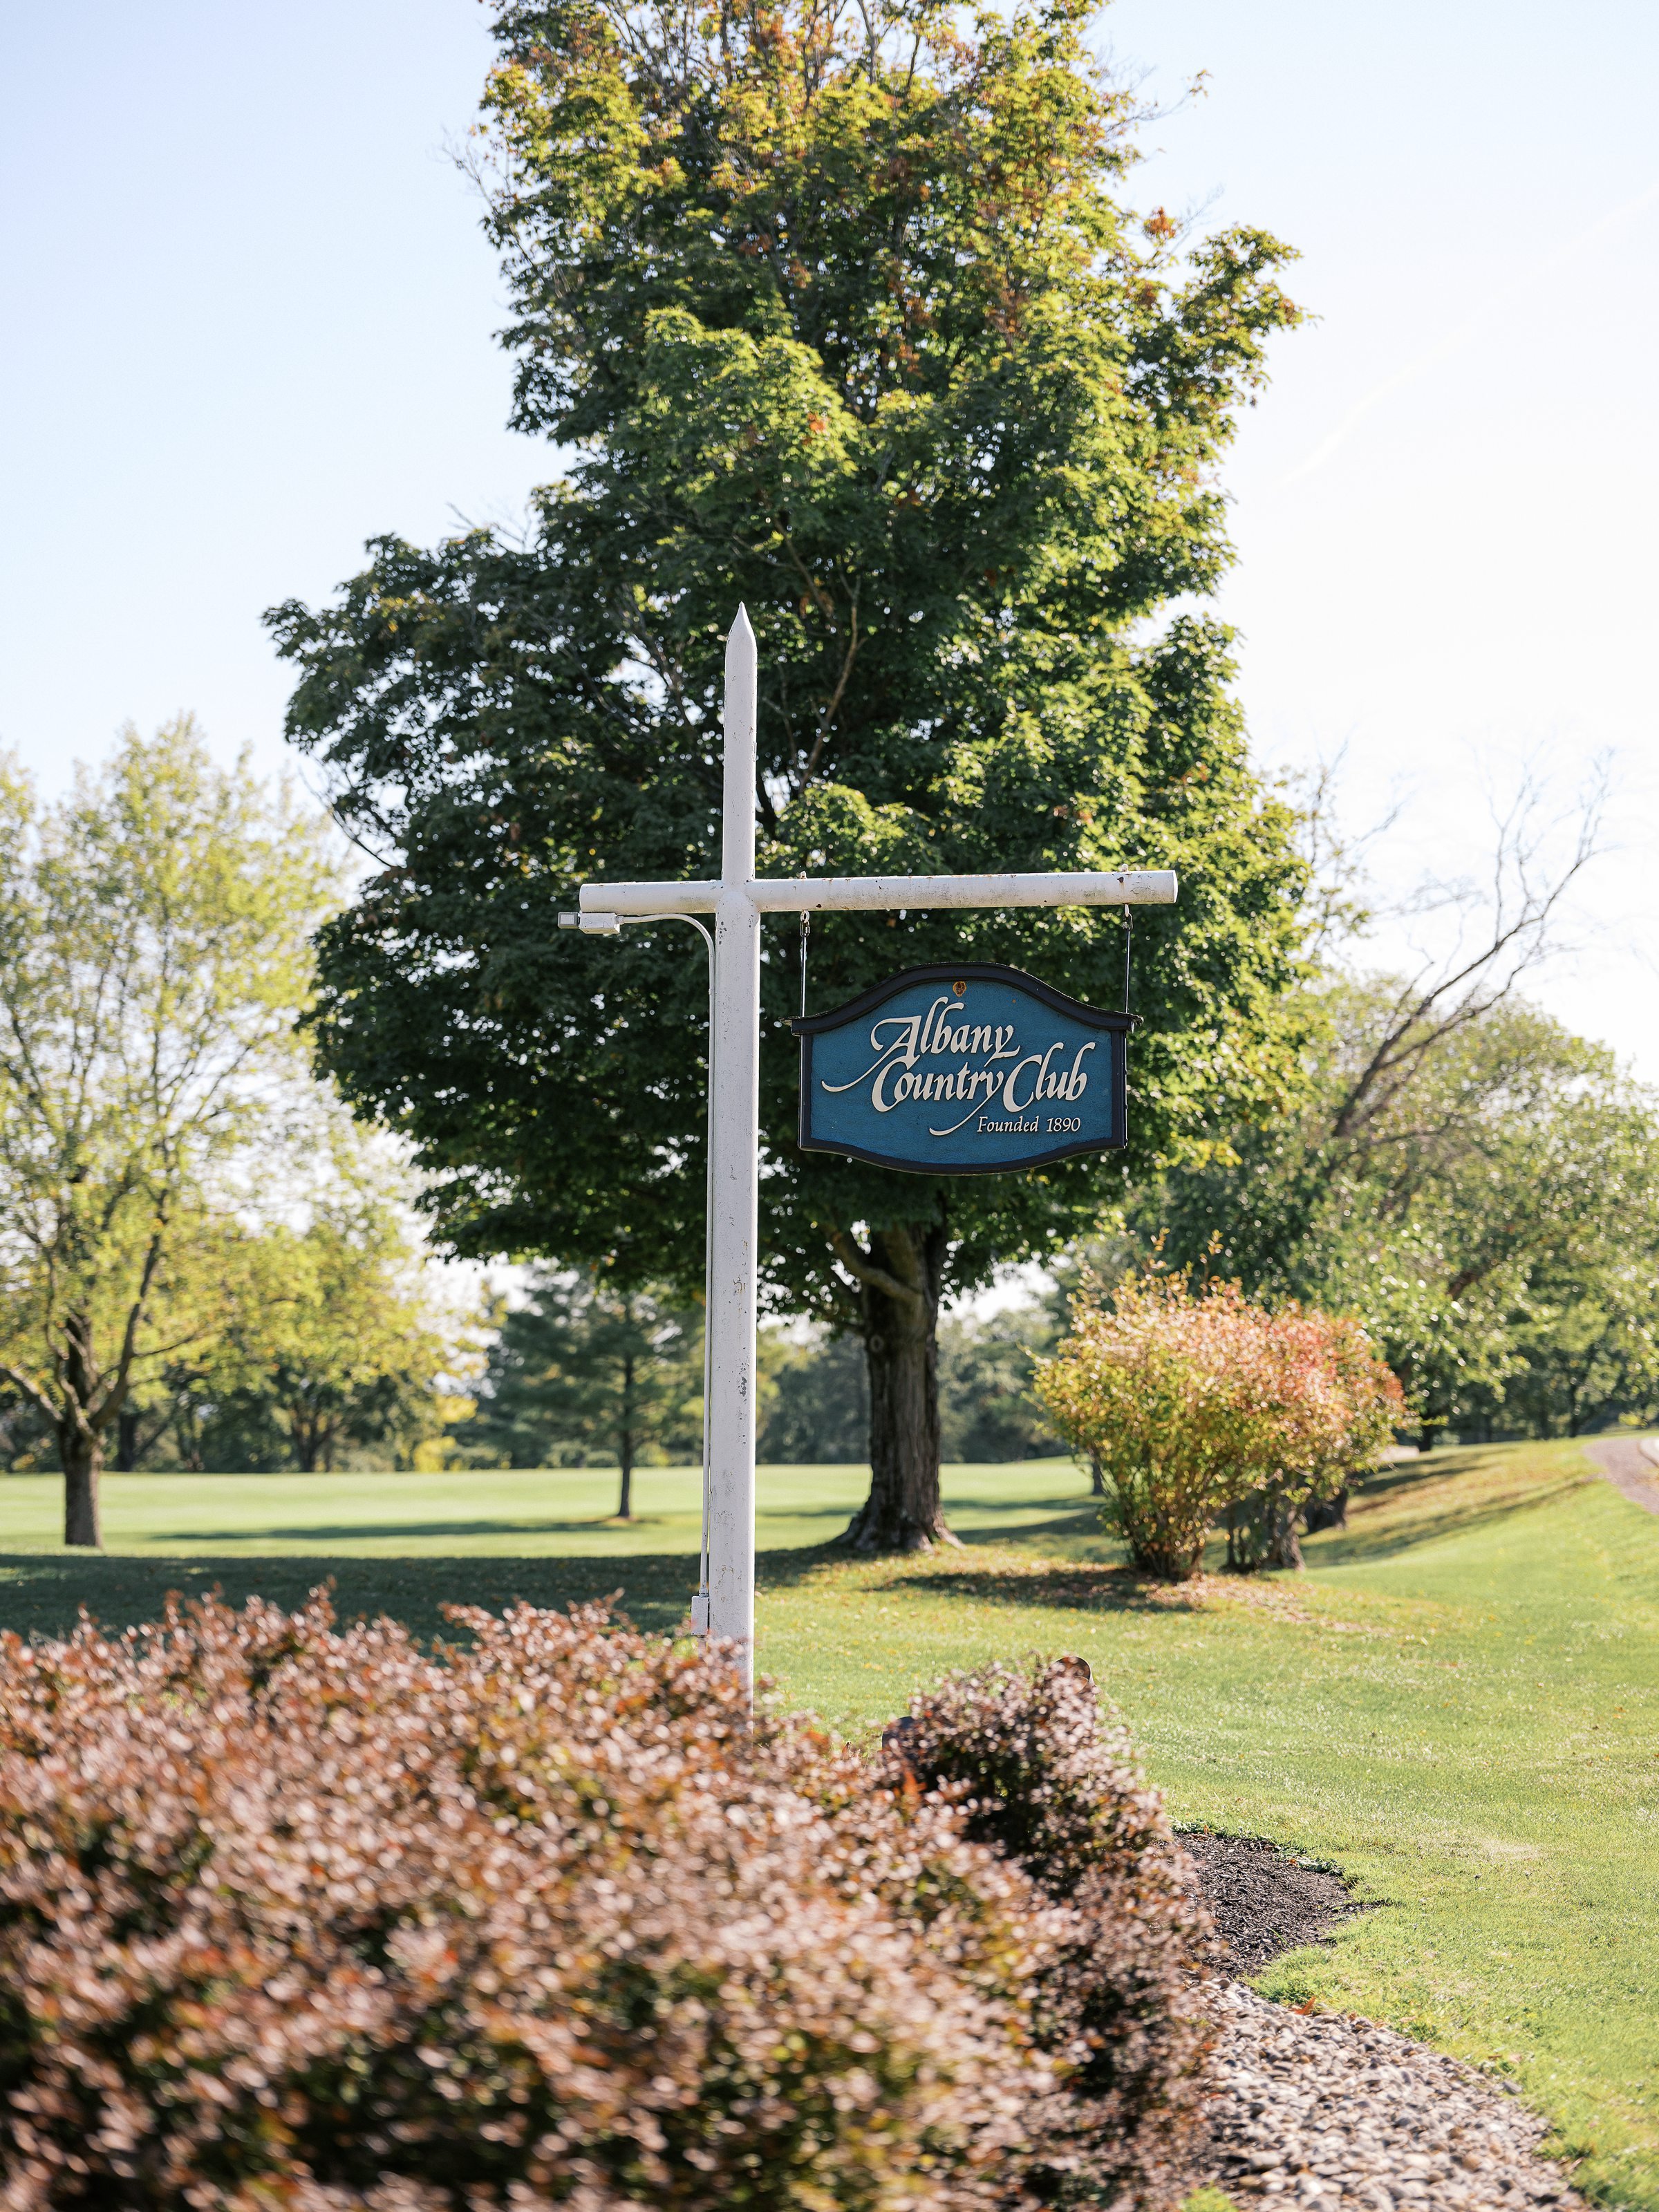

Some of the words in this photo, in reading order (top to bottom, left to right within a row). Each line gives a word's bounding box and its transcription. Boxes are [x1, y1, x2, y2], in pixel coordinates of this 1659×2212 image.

[821, 995, 1021, 1092] Albany
[872, 1055, 1005, 1135] Country
[1002, 1042, 1096, 1112] Club
[977, 1115, 1039, 1132] Founded
[1046, 1117, 1080, 1132] 1890
